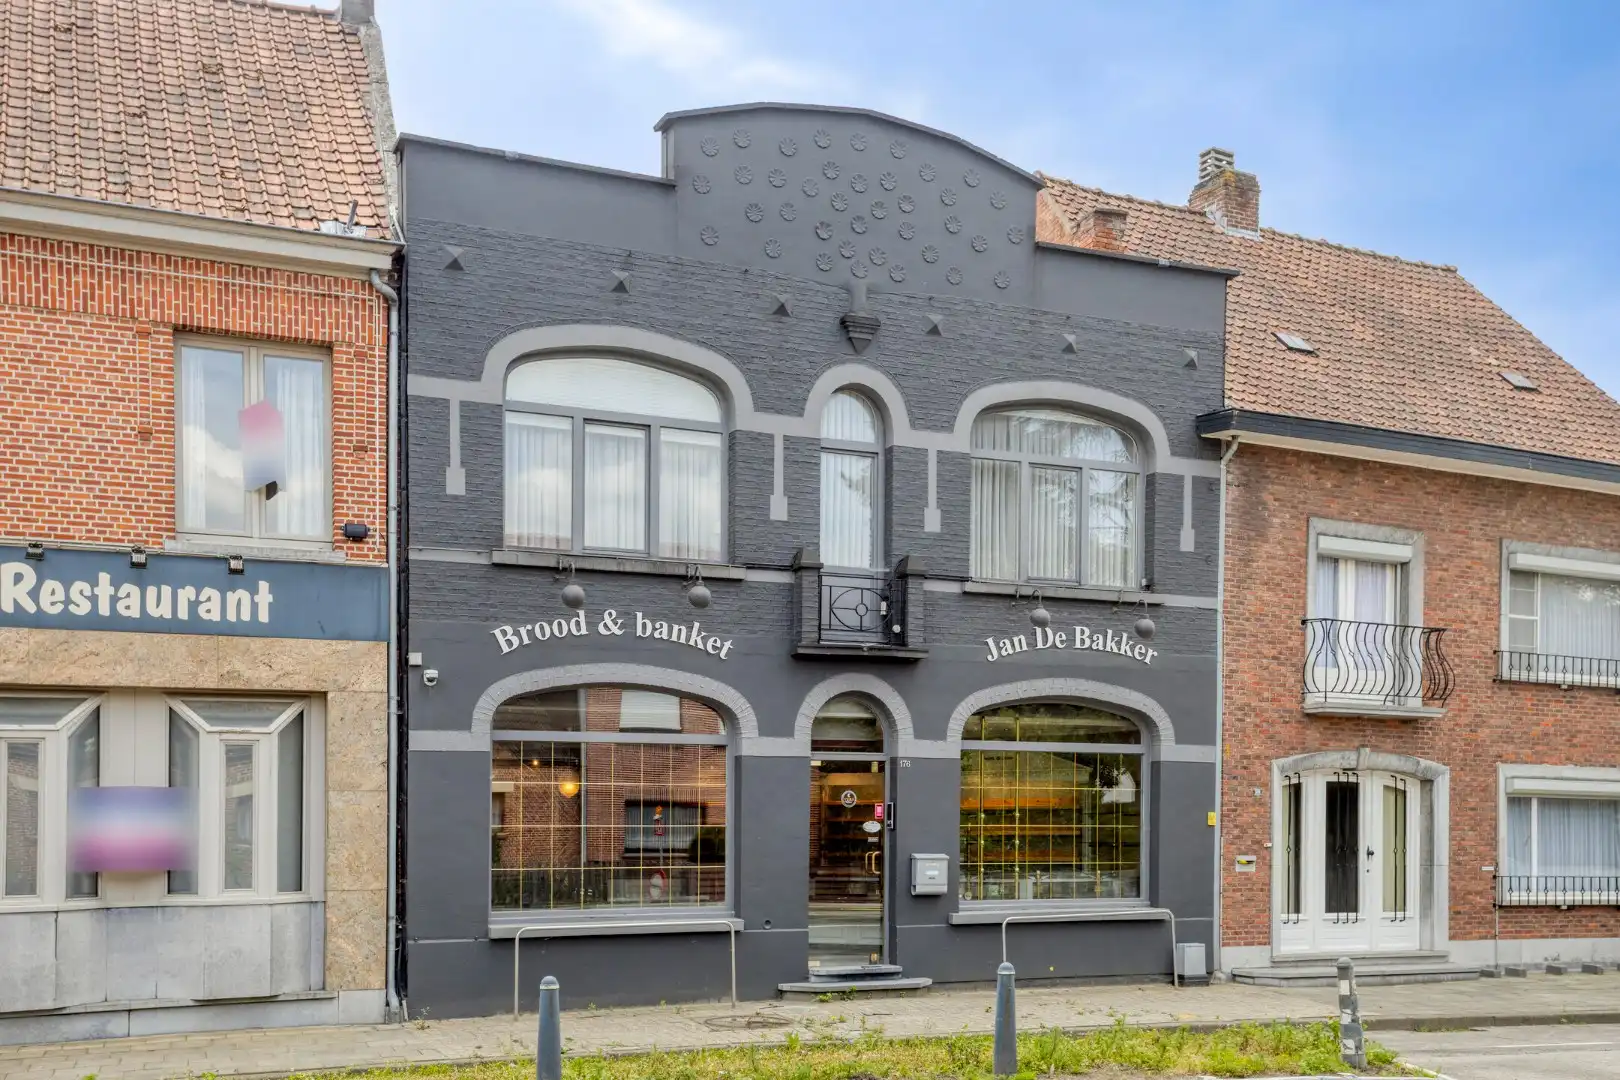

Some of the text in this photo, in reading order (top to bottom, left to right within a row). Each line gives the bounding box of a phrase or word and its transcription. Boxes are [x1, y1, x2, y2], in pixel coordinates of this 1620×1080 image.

[0, 561, 273, 623] Restaurant
[490, 609, 735, 660] Brood & banket
[984, 626, 1158, 665] Jan De Bakker
